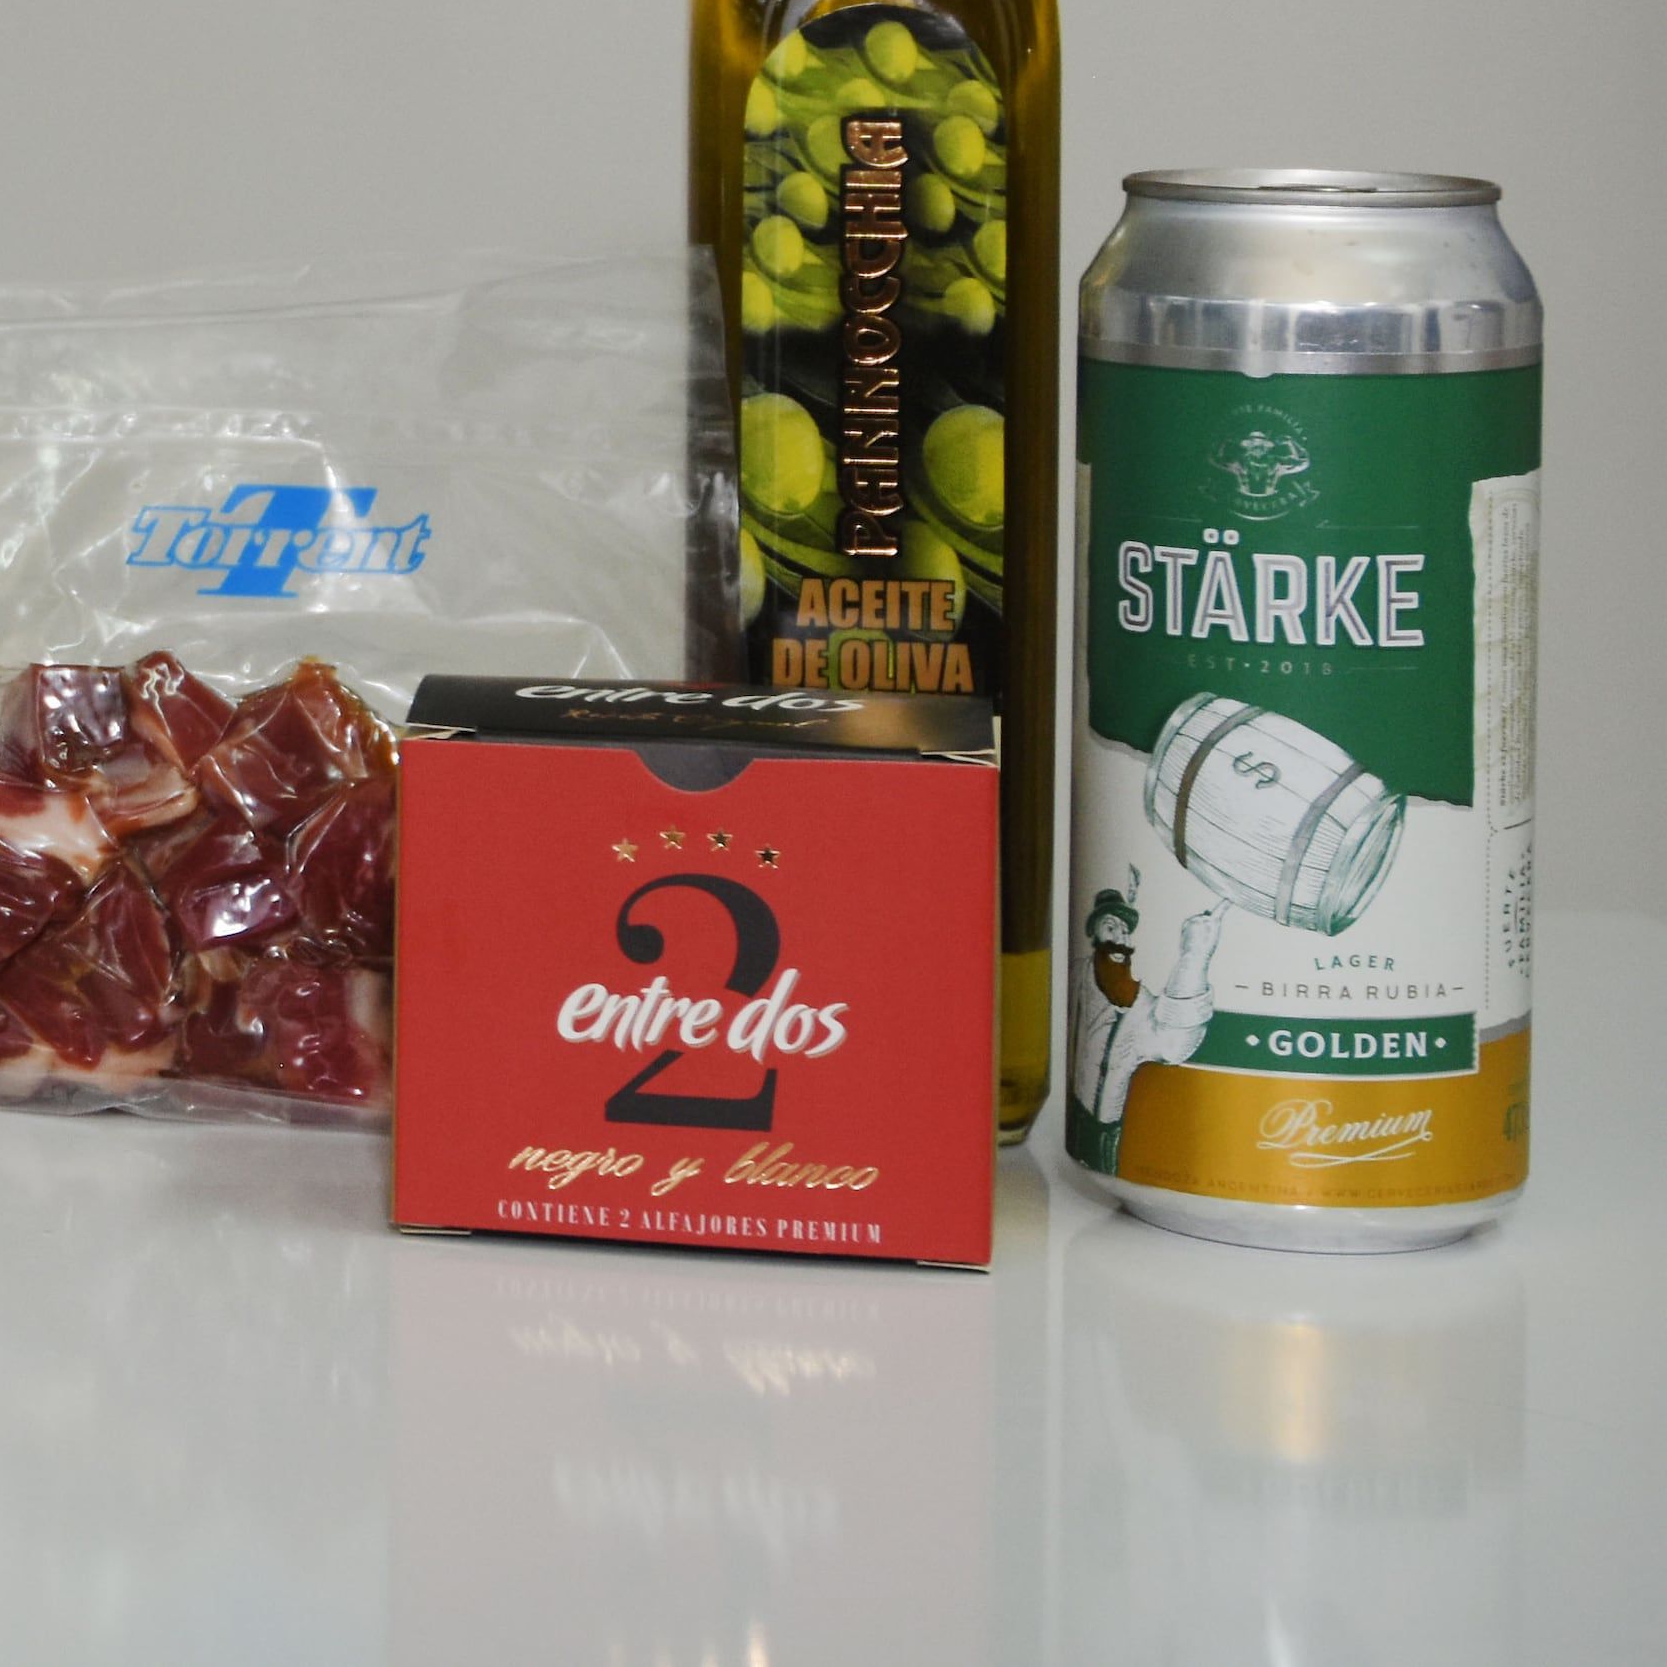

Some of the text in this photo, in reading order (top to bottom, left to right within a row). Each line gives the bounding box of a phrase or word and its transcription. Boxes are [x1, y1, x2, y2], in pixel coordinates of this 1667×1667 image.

[841, 118, 909, 559] PANNOCCHIA
[125, 498, 432, 580] Torrent
[795, 577, 957, 631] ACEITE
[1117, 527, 1426, 648] STÄRKE
[772, 637, 974, 694] DE OLIVA
[515, 683, 866, 713] entre dos
[1261, 980, 1449, 1001] BIRRA RUBIA
[1313, 953, 1397, 974] LAGER
[556, 968, 851, 1064] entre dos
[604, 872, 782, 1133] 2
[1268, 1029, 1429, 1060] GOLDEN
[1256, 1097, 1434, 1152] Premium
[508, 1140, 881, 1197] negro y blanco
[497, 1199, 884, 1245] CONTIENE 2 ALFAJORES PREMIUM
